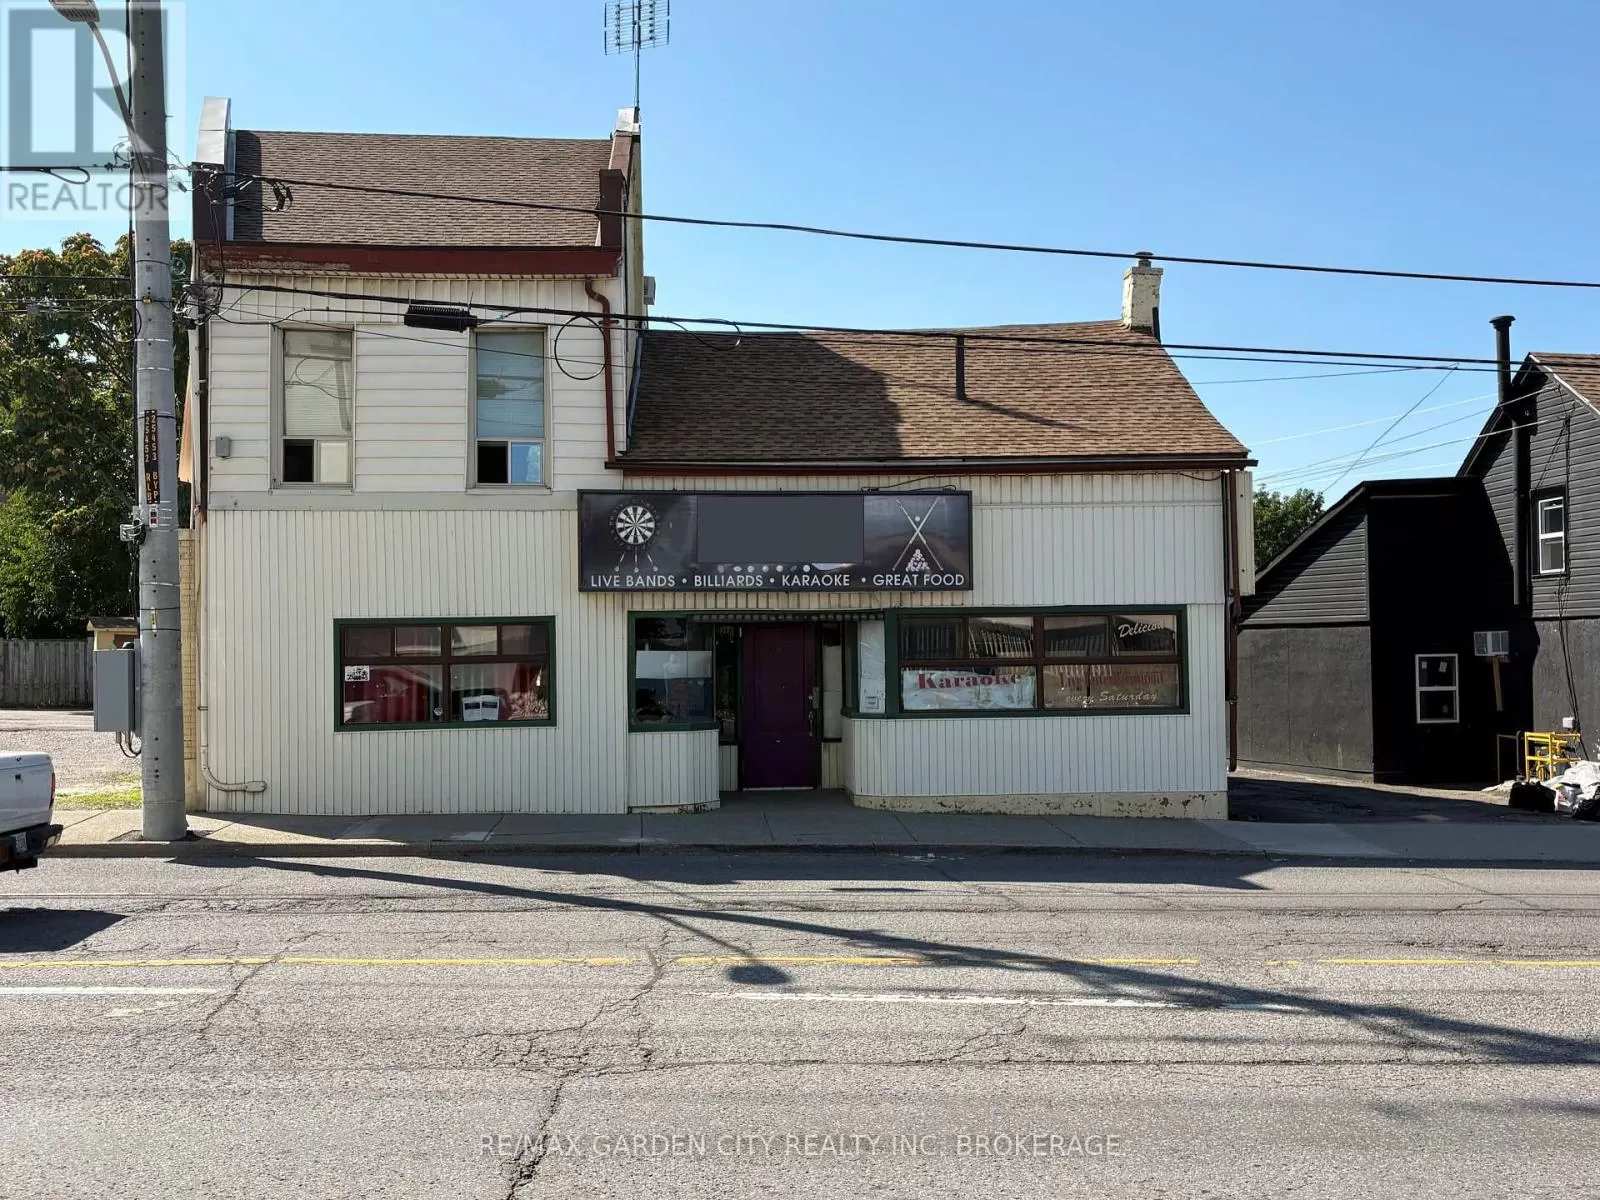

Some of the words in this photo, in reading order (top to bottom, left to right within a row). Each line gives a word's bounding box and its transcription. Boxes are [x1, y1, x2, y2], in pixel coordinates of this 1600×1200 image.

[590, 574, 621, 588] LIVE
[626, 574, 676, 588] BANDS
[694, 574, 764, 588] BILLIARDS
[782, 574, 850, 587] KARAOKE
[873, 573, 919, 587] GREAT
[923, 573, 965, 586] FOOD
[918, 669, 1021, 690] Karaoke
[1099, 690, 1158, 703] Saturday
